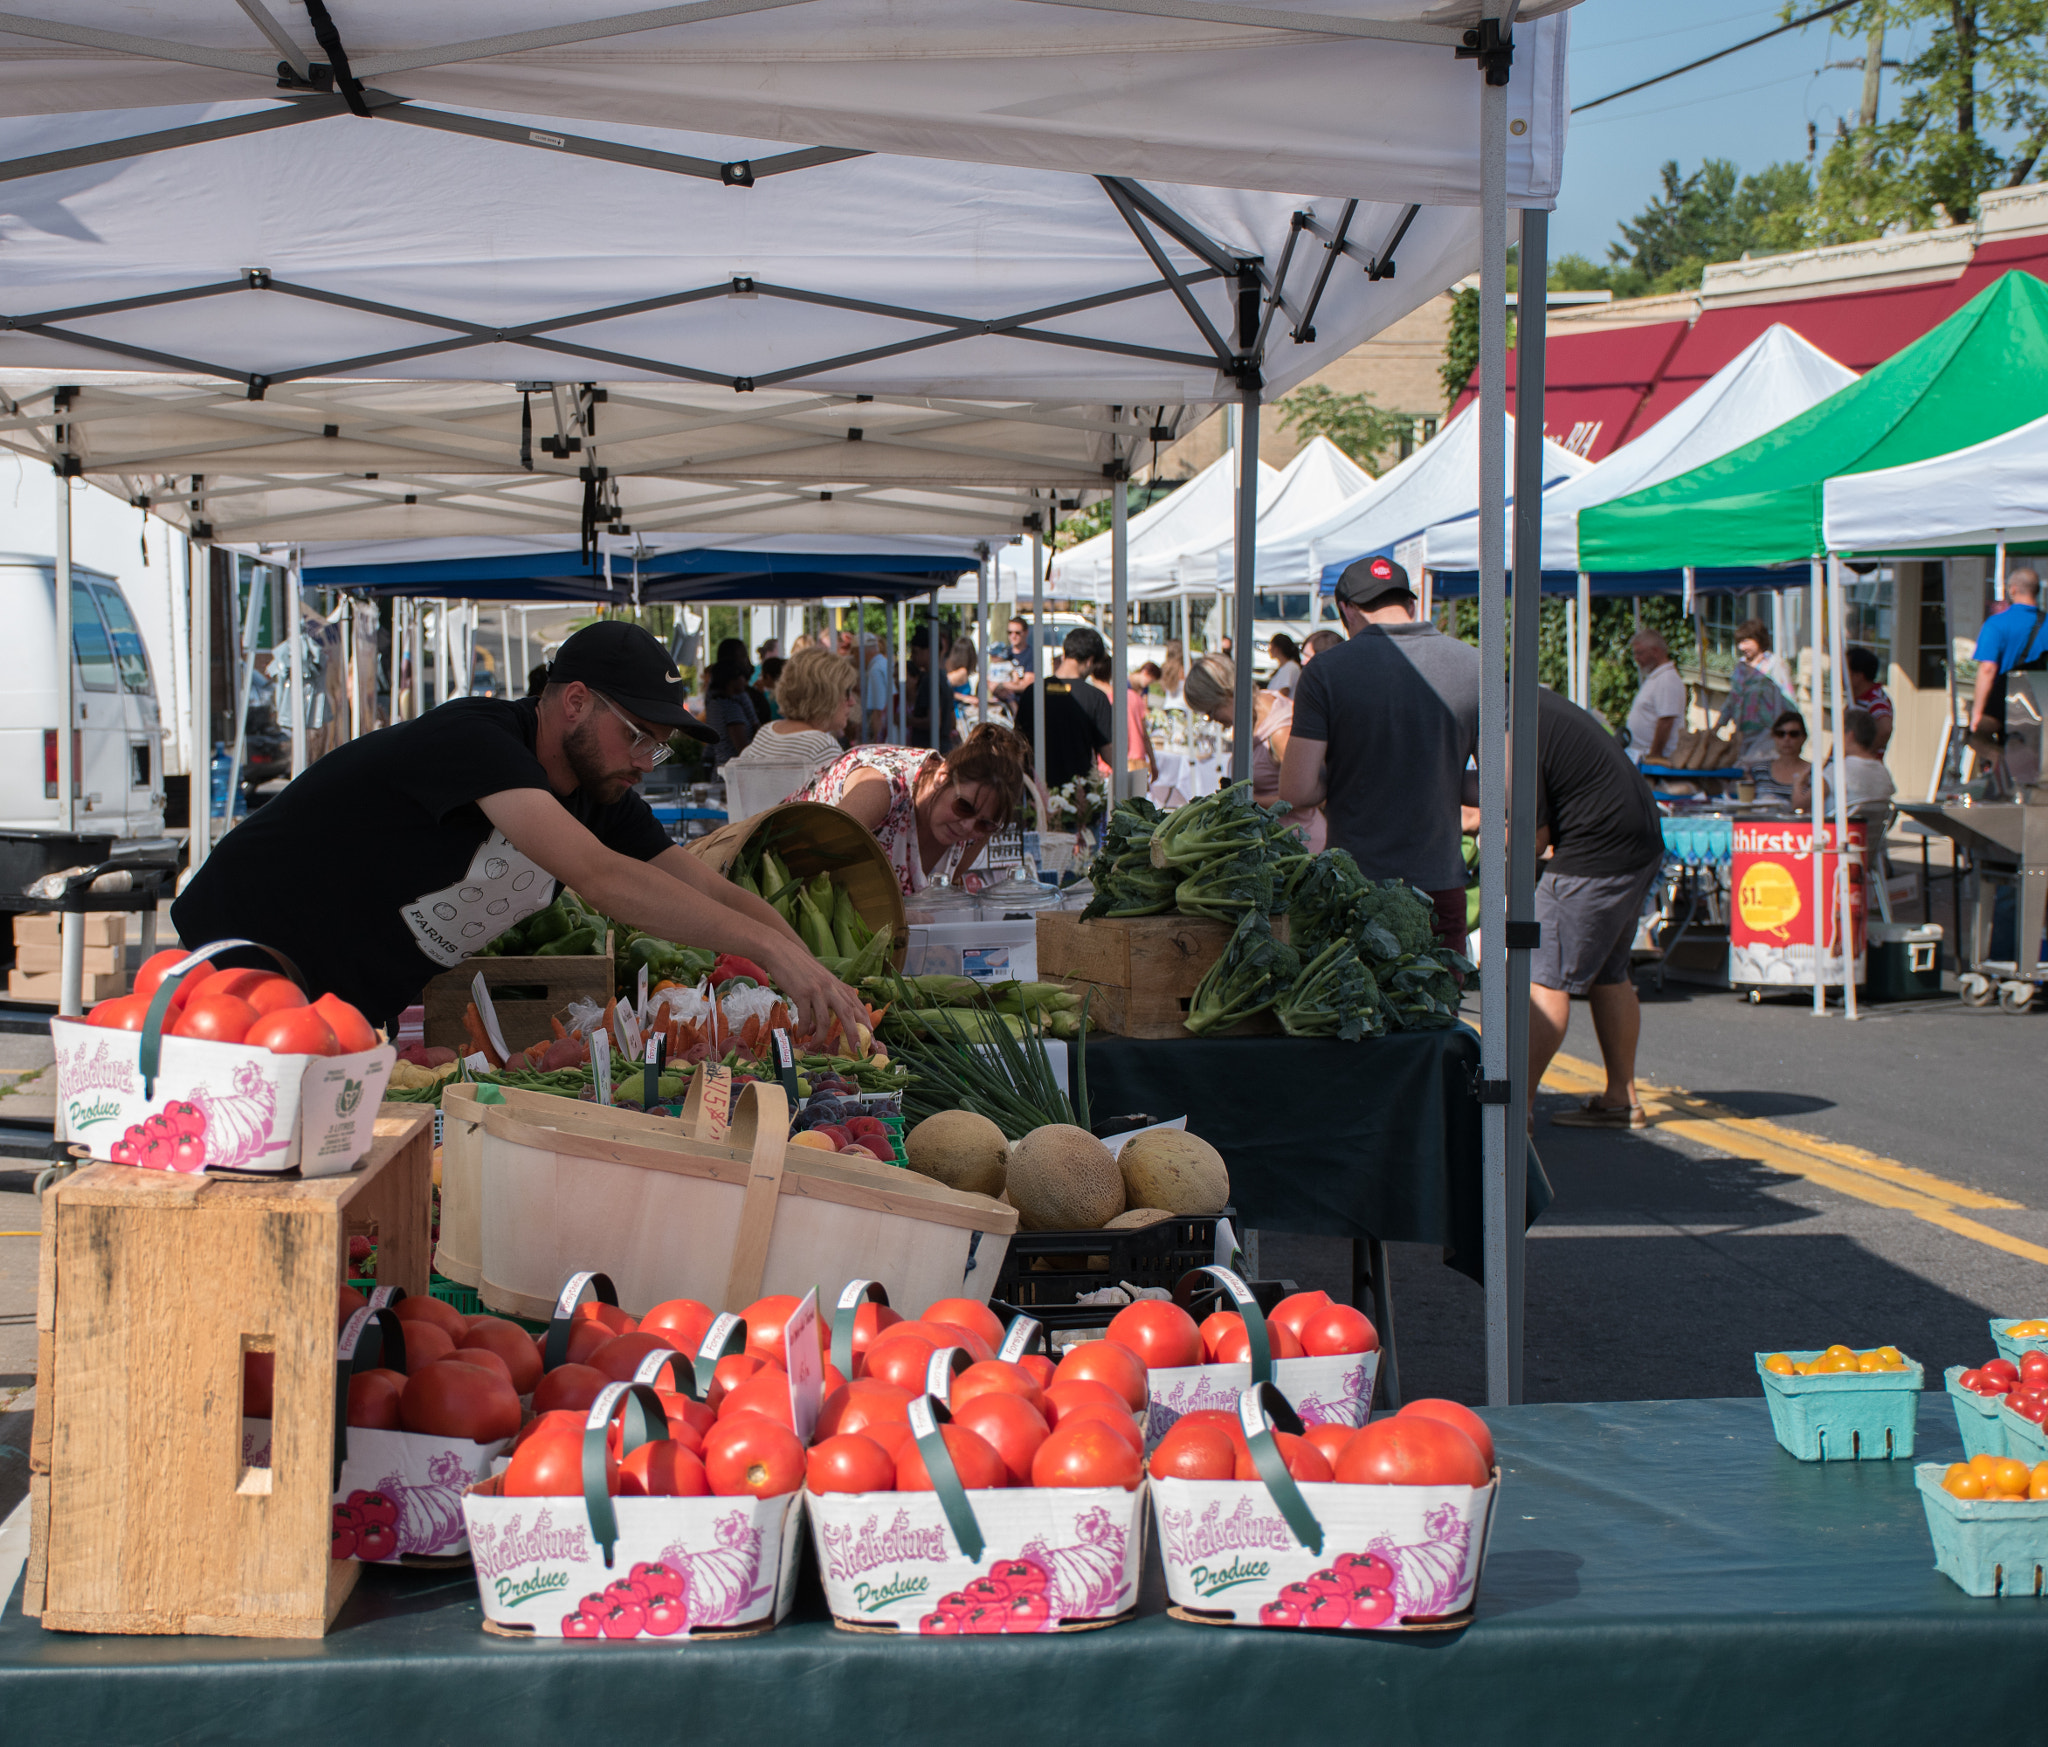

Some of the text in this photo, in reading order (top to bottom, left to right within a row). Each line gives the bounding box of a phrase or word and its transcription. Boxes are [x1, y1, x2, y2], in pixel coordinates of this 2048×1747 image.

[411, 910, 458, 953] FARMS
[69, 1095, 121, 1128] Produce
[470, 1507, 591, 1579] Shabatura
[823, 1508, 949, 1581] Shabatura
[495, 1567, 569, 1606] Produce
[854, 1572, 930, 1610] Produce
[1190, 1555, 1270, 1594] Produce
